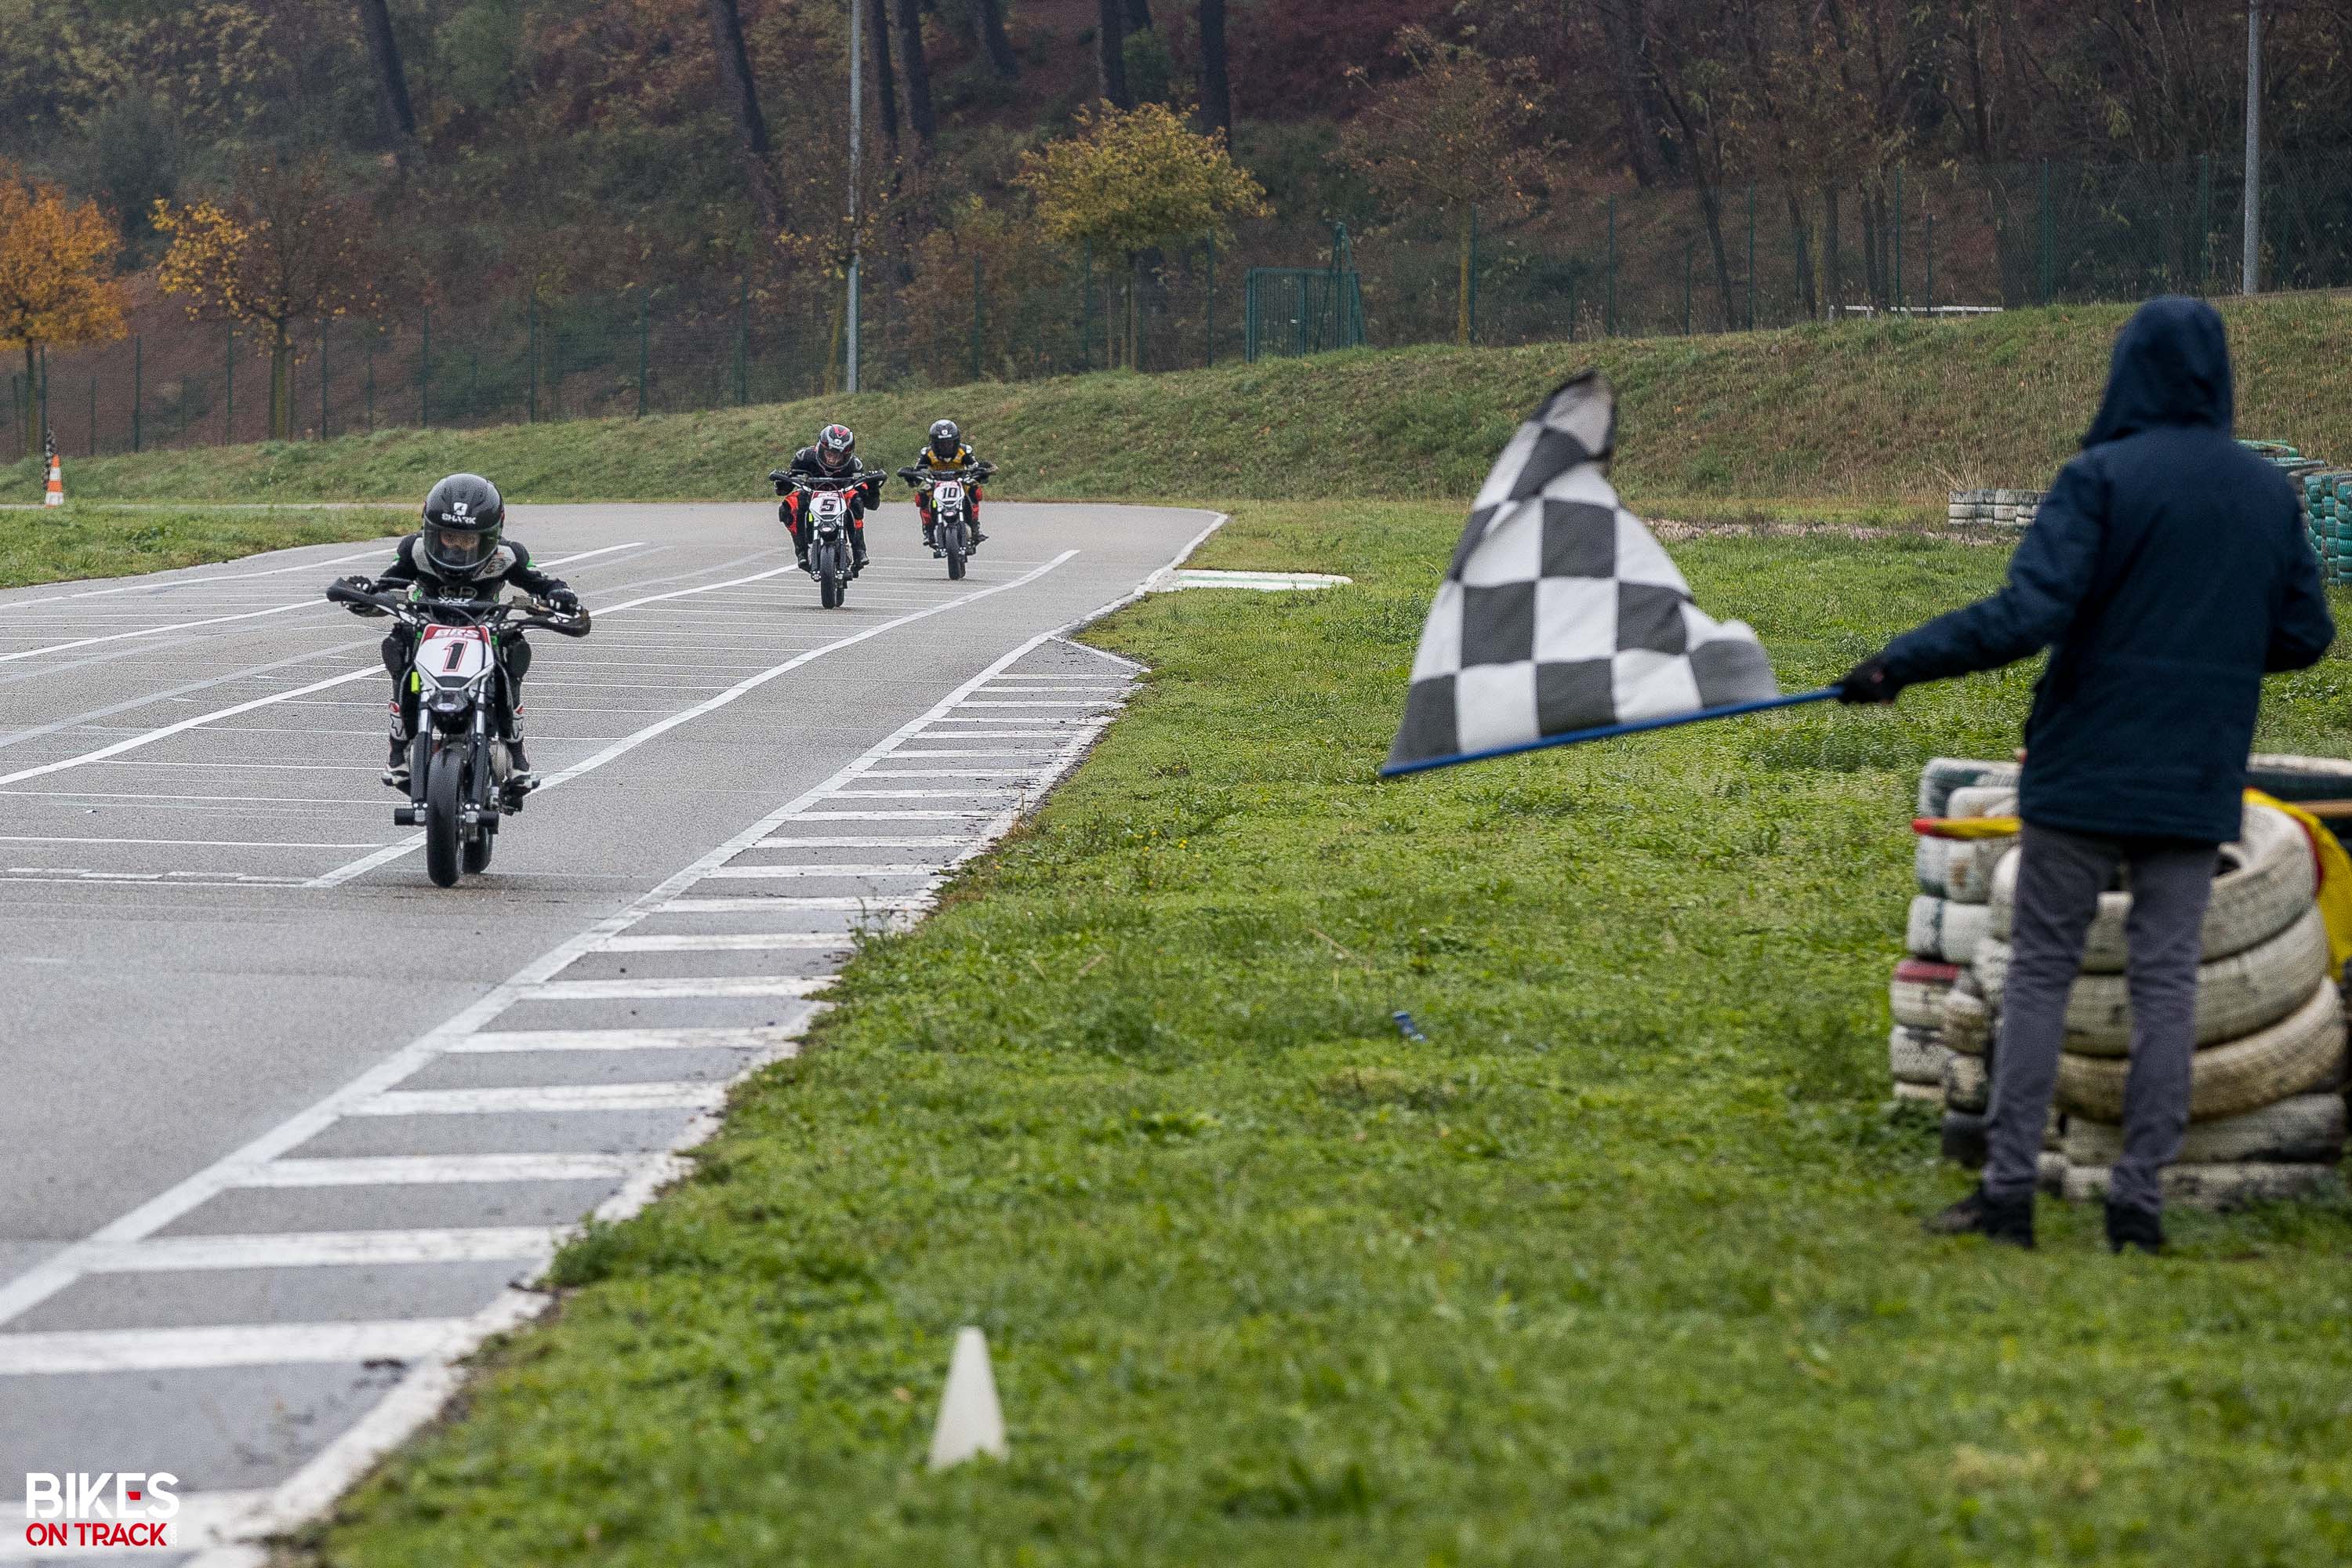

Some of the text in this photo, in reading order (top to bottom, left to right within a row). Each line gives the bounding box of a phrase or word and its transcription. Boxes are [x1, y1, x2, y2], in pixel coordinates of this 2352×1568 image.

[942, 487, 958, 499] 10
[820, 498, 838, 513] 5
[441, 513, 477, 524] SHARK
[442, 639, 469, 672] 1
